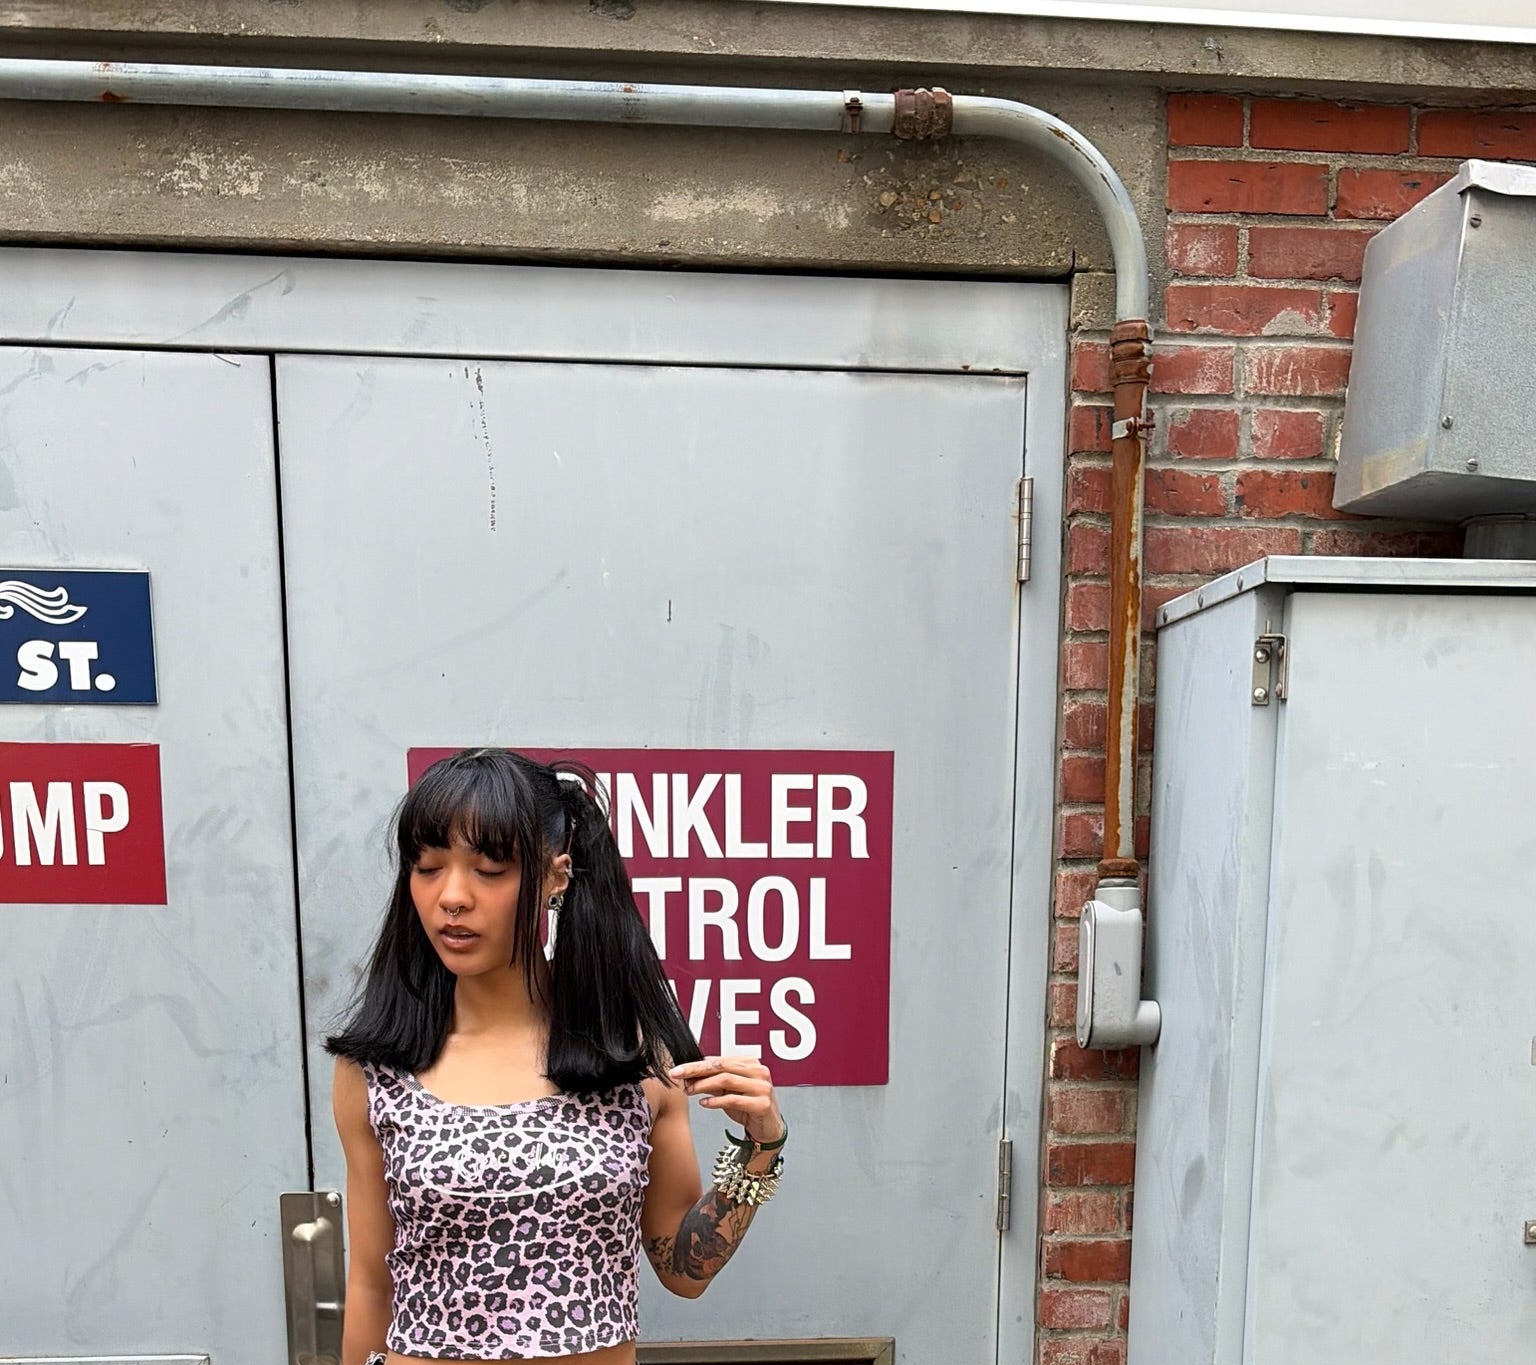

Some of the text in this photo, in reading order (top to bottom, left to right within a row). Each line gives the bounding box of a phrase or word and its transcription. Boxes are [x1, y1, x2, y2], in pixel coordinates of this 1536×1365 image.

[17, 640, 116, 691] ST.
[0, 781, 130, 866] MP
[631, 875, 852, 962] TROL
[668, 976, 818, 1061] VES
